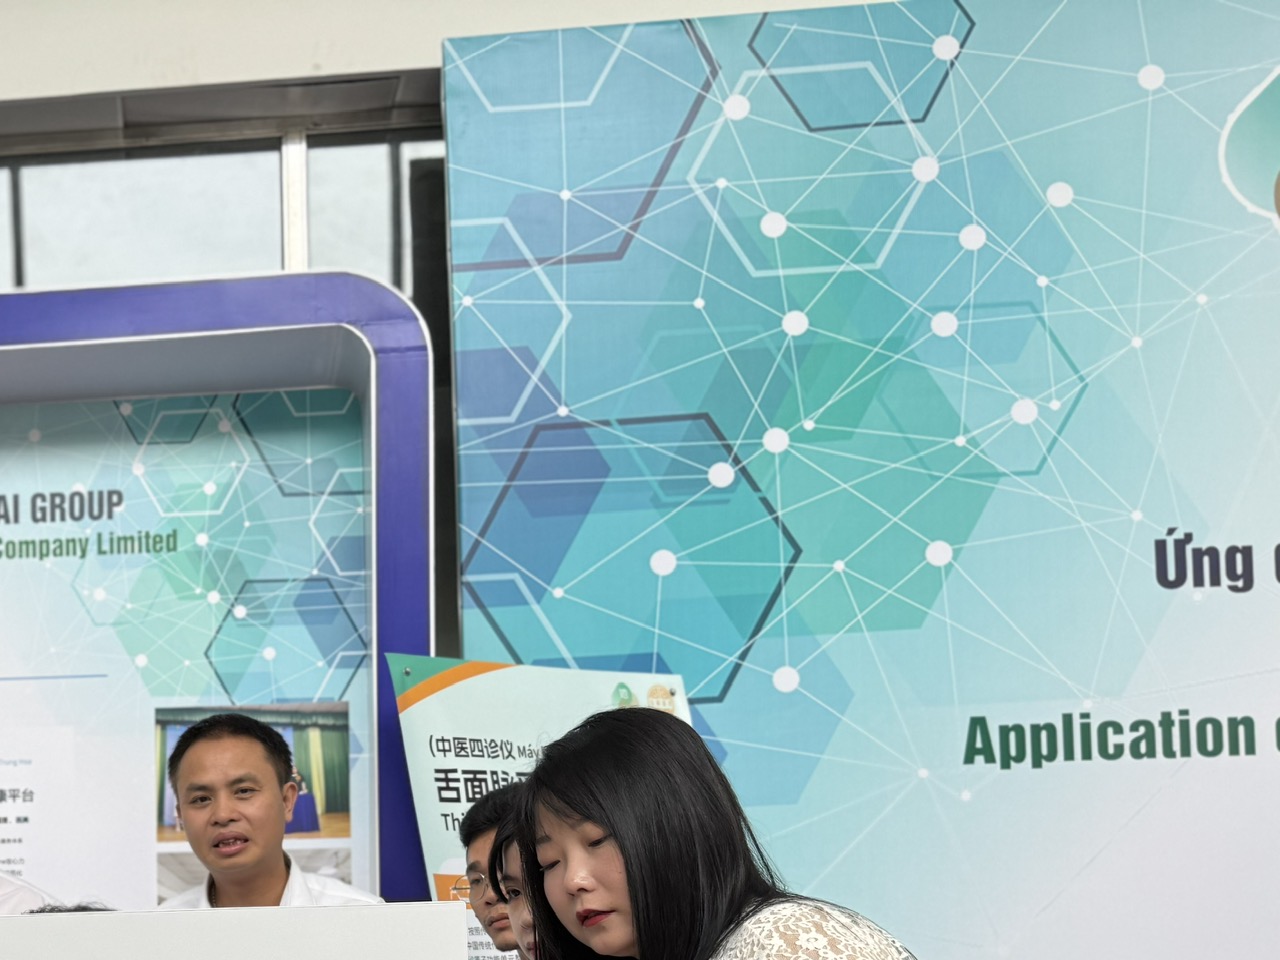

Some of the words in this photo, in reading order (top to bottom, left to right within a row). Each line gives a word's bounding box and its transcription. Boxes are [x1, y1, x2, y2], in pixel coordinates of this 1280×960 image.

[30, 490, 123, 523] GROUP
[97, 529, 177, 555] Limited
[1154, 527, 1254, 593] Ứng
[963, 709, 1256, 770] Application
